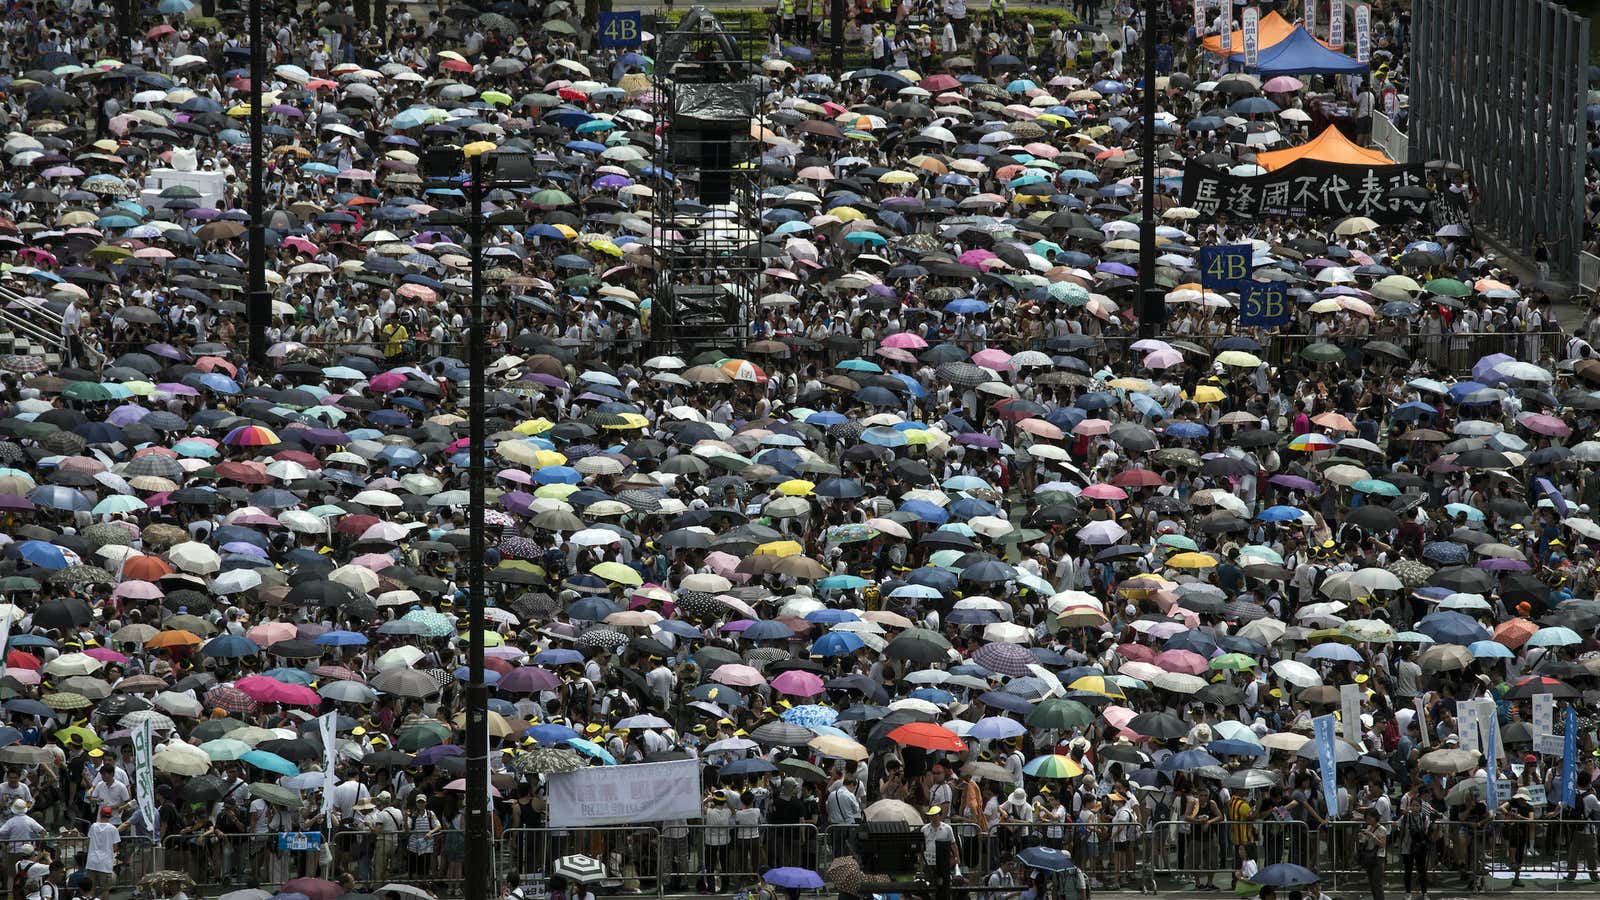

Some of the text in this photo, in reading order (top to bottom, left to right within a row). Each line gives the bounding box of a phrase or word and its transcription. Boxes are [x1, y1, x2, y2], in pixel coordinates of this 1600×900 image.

[604, 19, 637, 41] 4B
[1207, 255, 1246, 279] 4B
[1247, 291, 1282, 317] 5B
